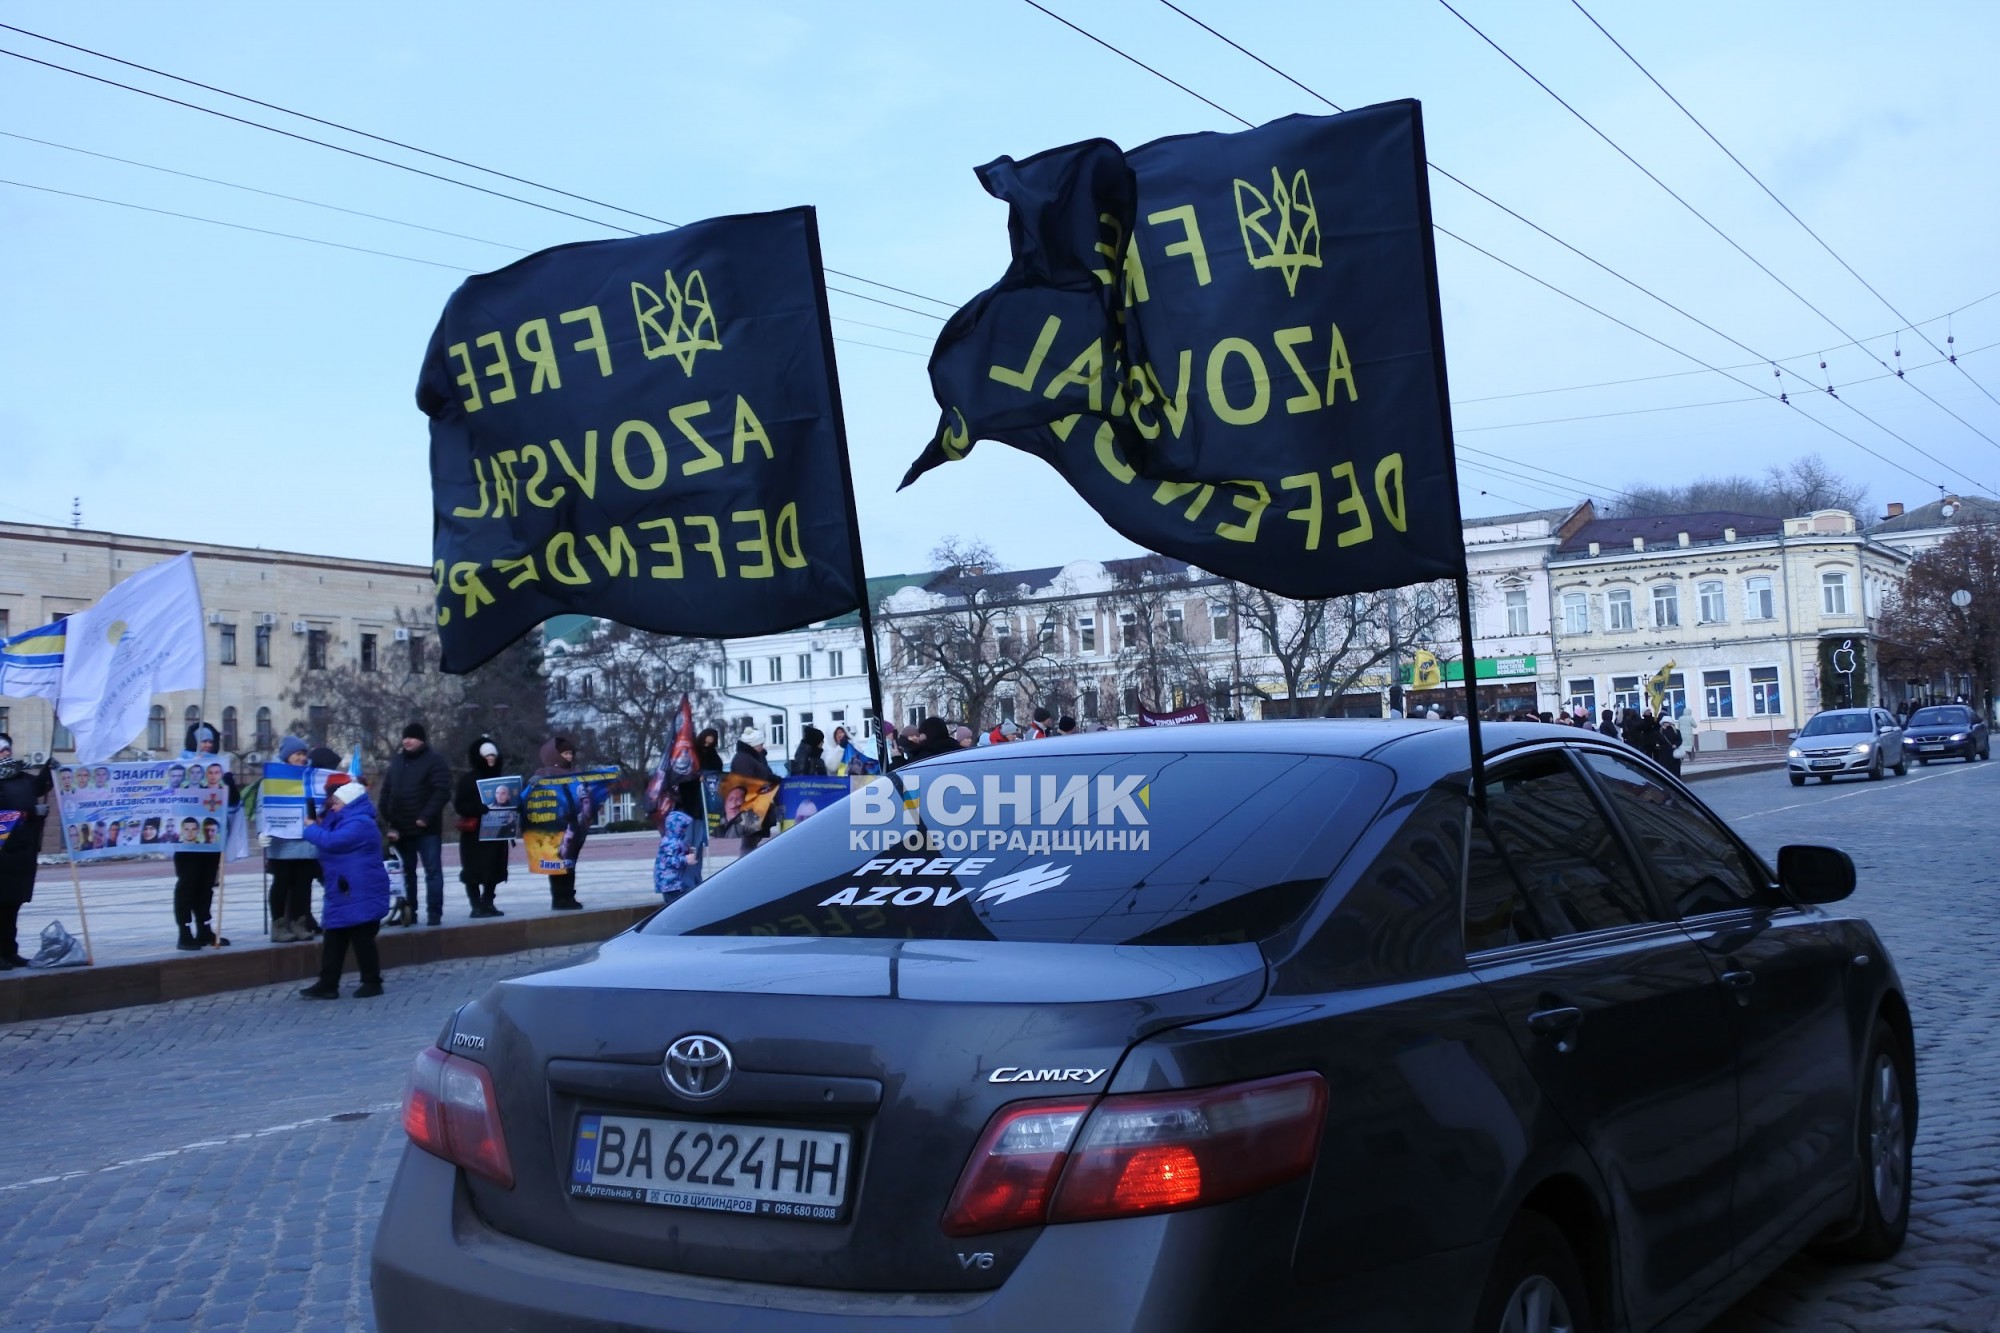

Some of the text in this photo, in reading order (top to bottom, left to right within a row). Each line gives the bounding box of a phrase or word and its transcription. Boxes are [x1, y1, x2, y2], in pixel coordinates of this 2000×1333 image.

[115, 785, 163, 793] ПОВЕРНУТИ
[158, 796, 199, 804] МОРЯКІВ
[852, 857, 997, 877] FREE
[817, 886, 976, 907] AZOV
[453, 1033, 485, 1049] TOYOTA
[988, 1067, 1108, 1084] CAMRY
[575, 1158, 591, 1175] UA
[570, 1184, 642, 1200] ул. Артельная, 6
[663, 1193, 753, 1211] СТО 8 ЦИЛИНДРОВ
[957, 1252, 995, 1270] V6
